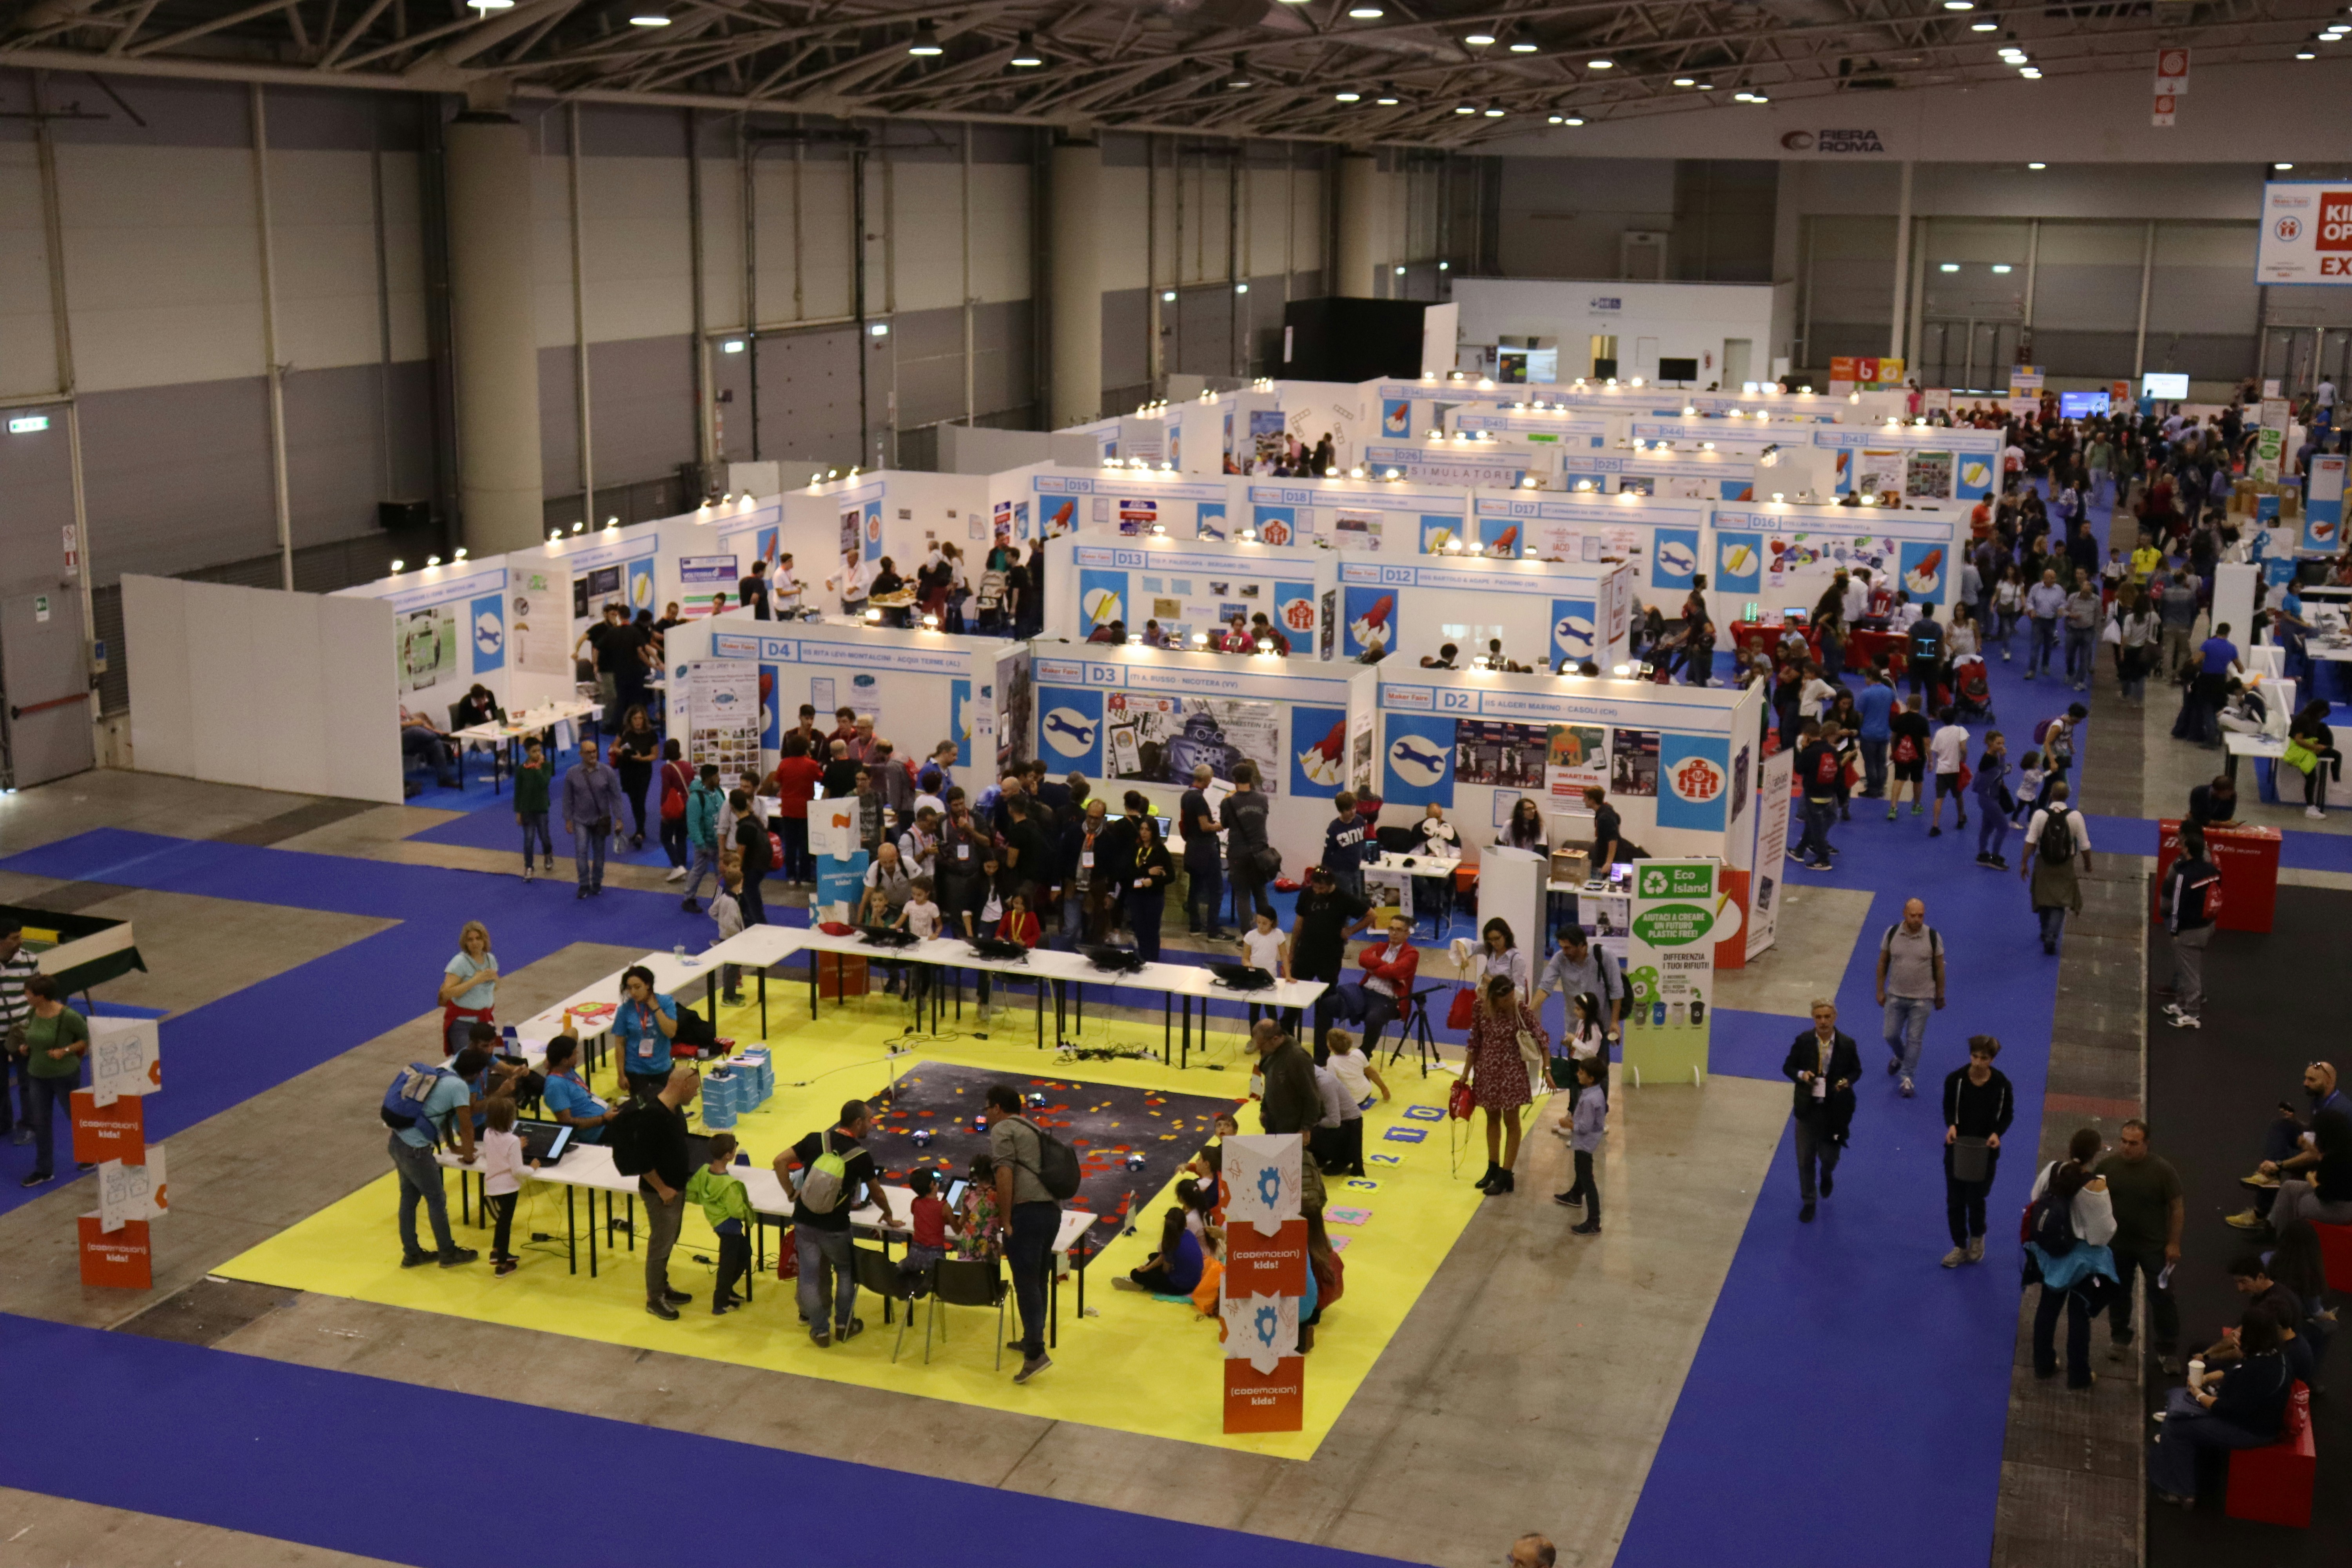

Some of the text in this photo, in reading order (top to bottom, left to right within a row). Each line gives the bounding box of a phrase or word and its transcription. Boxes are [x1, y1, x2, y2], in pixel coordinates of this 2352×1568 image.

[1820, 129, 1878, 140] FIERA
[1819, 141, 1885, 152] ROMA
[2326, 204, 2352, 222] KI
[1598, 461, 1619, 470] D25
[1412, 466, 1511, 480] SIMULATORE
[1069, 481, 1089, 490] D19
[1286, 492, 1307, 502] D18
[1515, 504, 1535, 514] D17
[1753, 517, 1775, 527] D16
[1118, 554, 1142, 565] D13
[1386, 570, 1411, 581] D12
[768, 642, 790, 657] D4
[831, 651, 891, 661] LEVI-MONTALCINI
[897, 656, 918, 664] ACQUI
[1093, 667, 1115, 682] D3
[1150, 675, 1176, 683] RUSSO
[1182, 678, 1220, 686] NICOTERA
[1221, 681, 1238, 689] (VV)
[1444, 693, 1469, 708] D2
[1498, 701, 1526, 709] ALGERI
[1529, 703, 1561, 711] MARINO
[1568, 706, 1597, 714] CASOLI
[1600, 708, 1618, 717] (CH)
[1674, 869, 1696, 880] Eco
[1673, 883, 1708, 893] Island
[98, 1130, 120, 1139] kids!
[1370, 1154, 1401, 1163] 2
[1348, 1180, 1377, 1189] 3
[1333, 1211, 1363, 1221] 4
[106, 1254, 129, 1263] kids!
[1254, 1261, 1279, 1270] kids!
[1251, 1397, 1276, 1406] kids!
